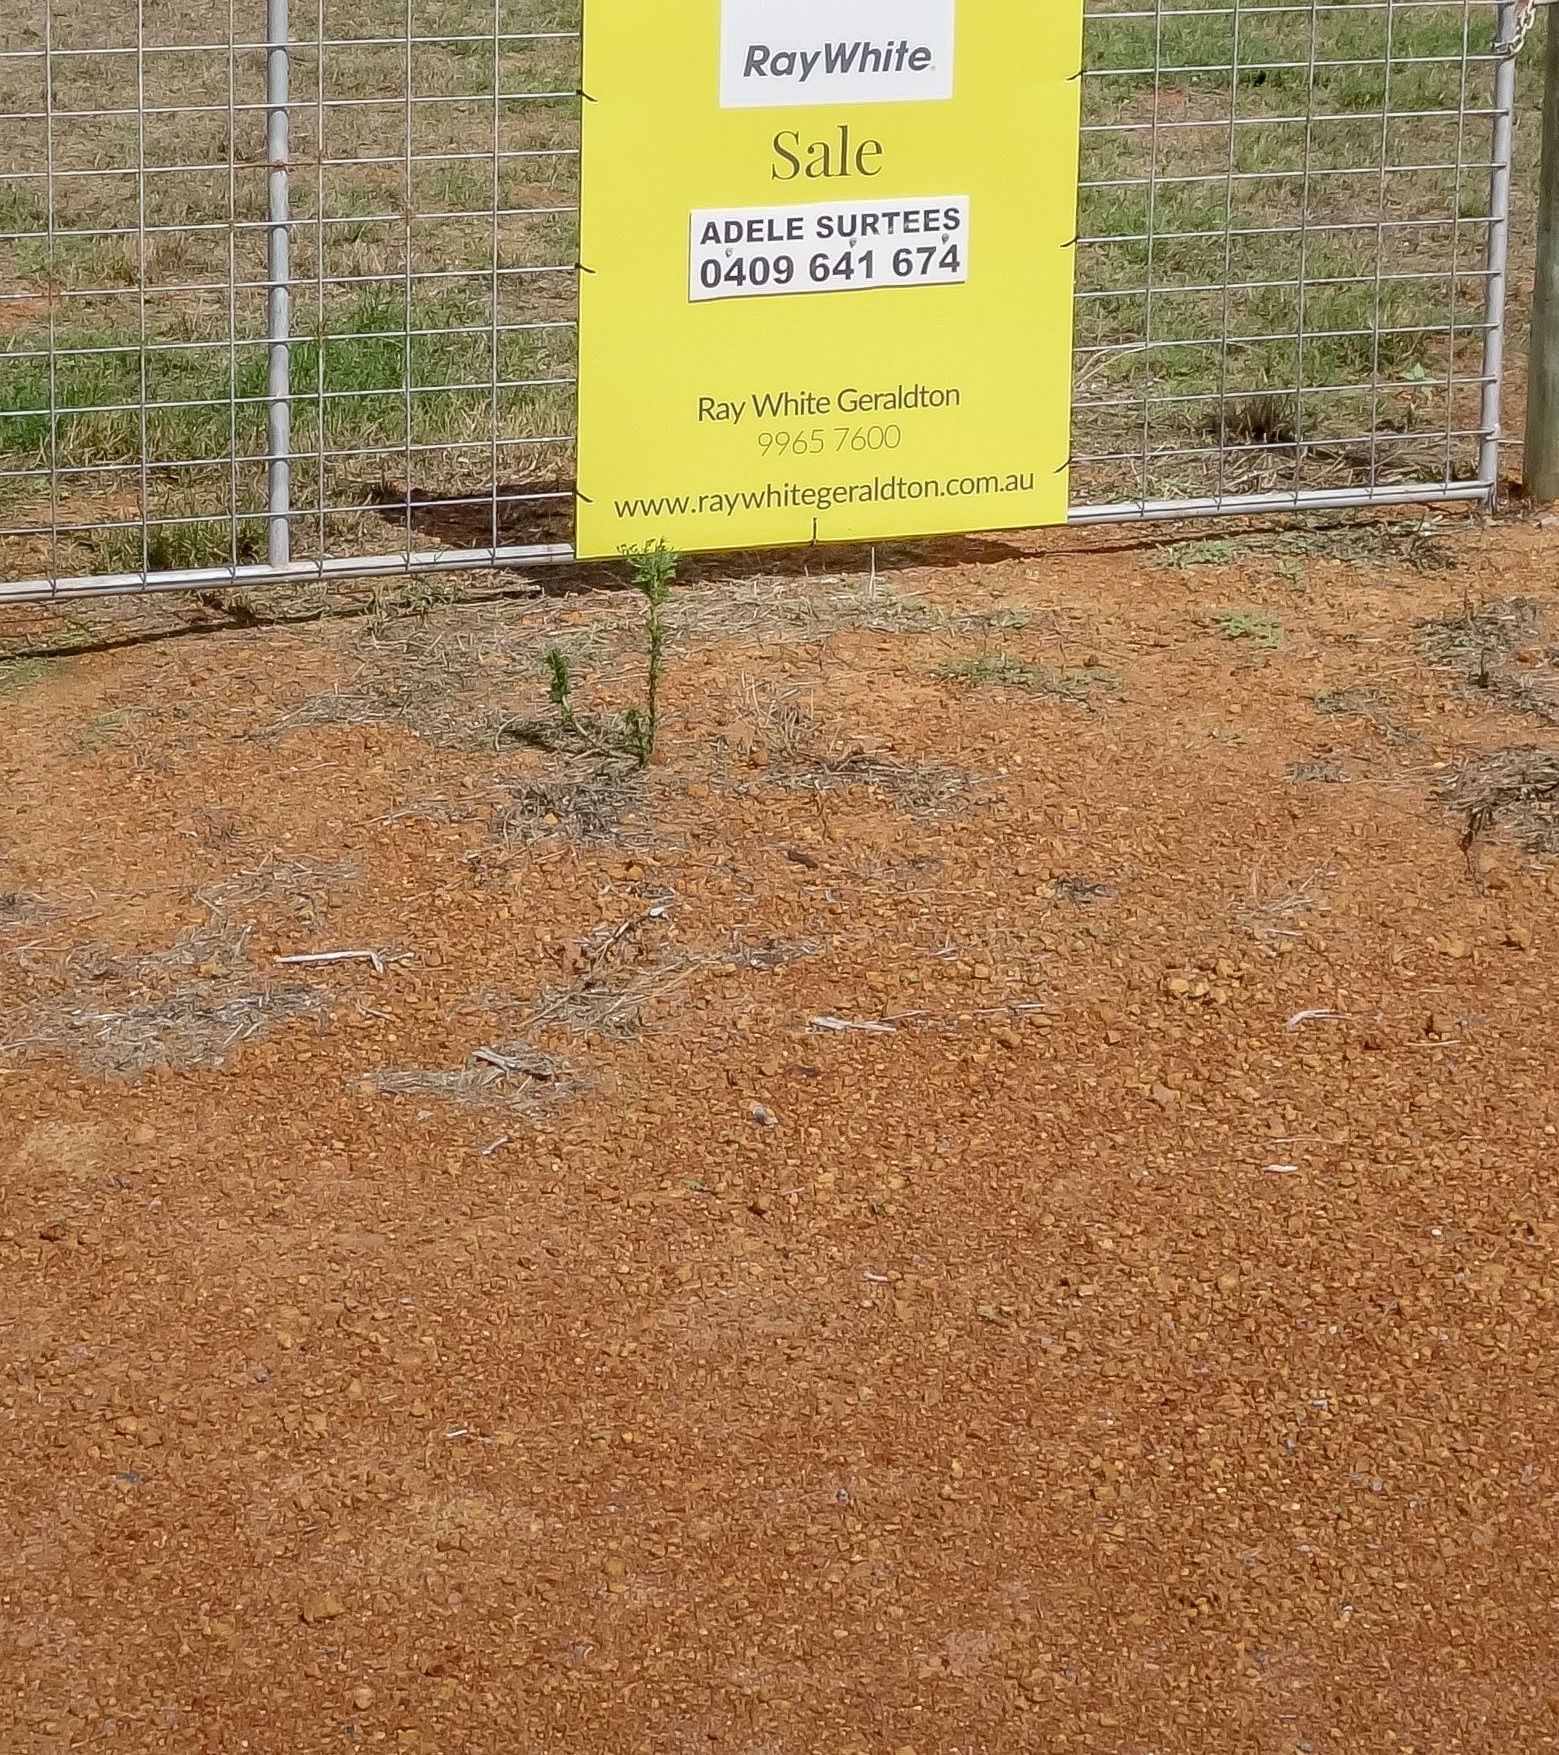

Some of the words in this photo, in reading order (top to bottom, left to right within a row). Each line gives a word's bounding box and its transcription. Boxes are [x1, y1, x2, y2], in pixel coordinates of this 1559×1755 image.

[771, 124, 883, 180] Sale
[700, 217, 804, 245] ADELE
[816, 207, 961, 239] SURTEES
[700, 255, 795, 288] 0409
[809, 249, 874, 282] 641
[892, 244, 961, 277] 674
[698, 397, 746, 424] Ray
[751, 390, 831, 417] White
[838, 383, 960, 412] Geraldton
[757, 429, 824, 457] 9965
[834, 424, 901, 452] 7600
[614, 472, 1034, 518] www.raywhitegeraldton.com.au
